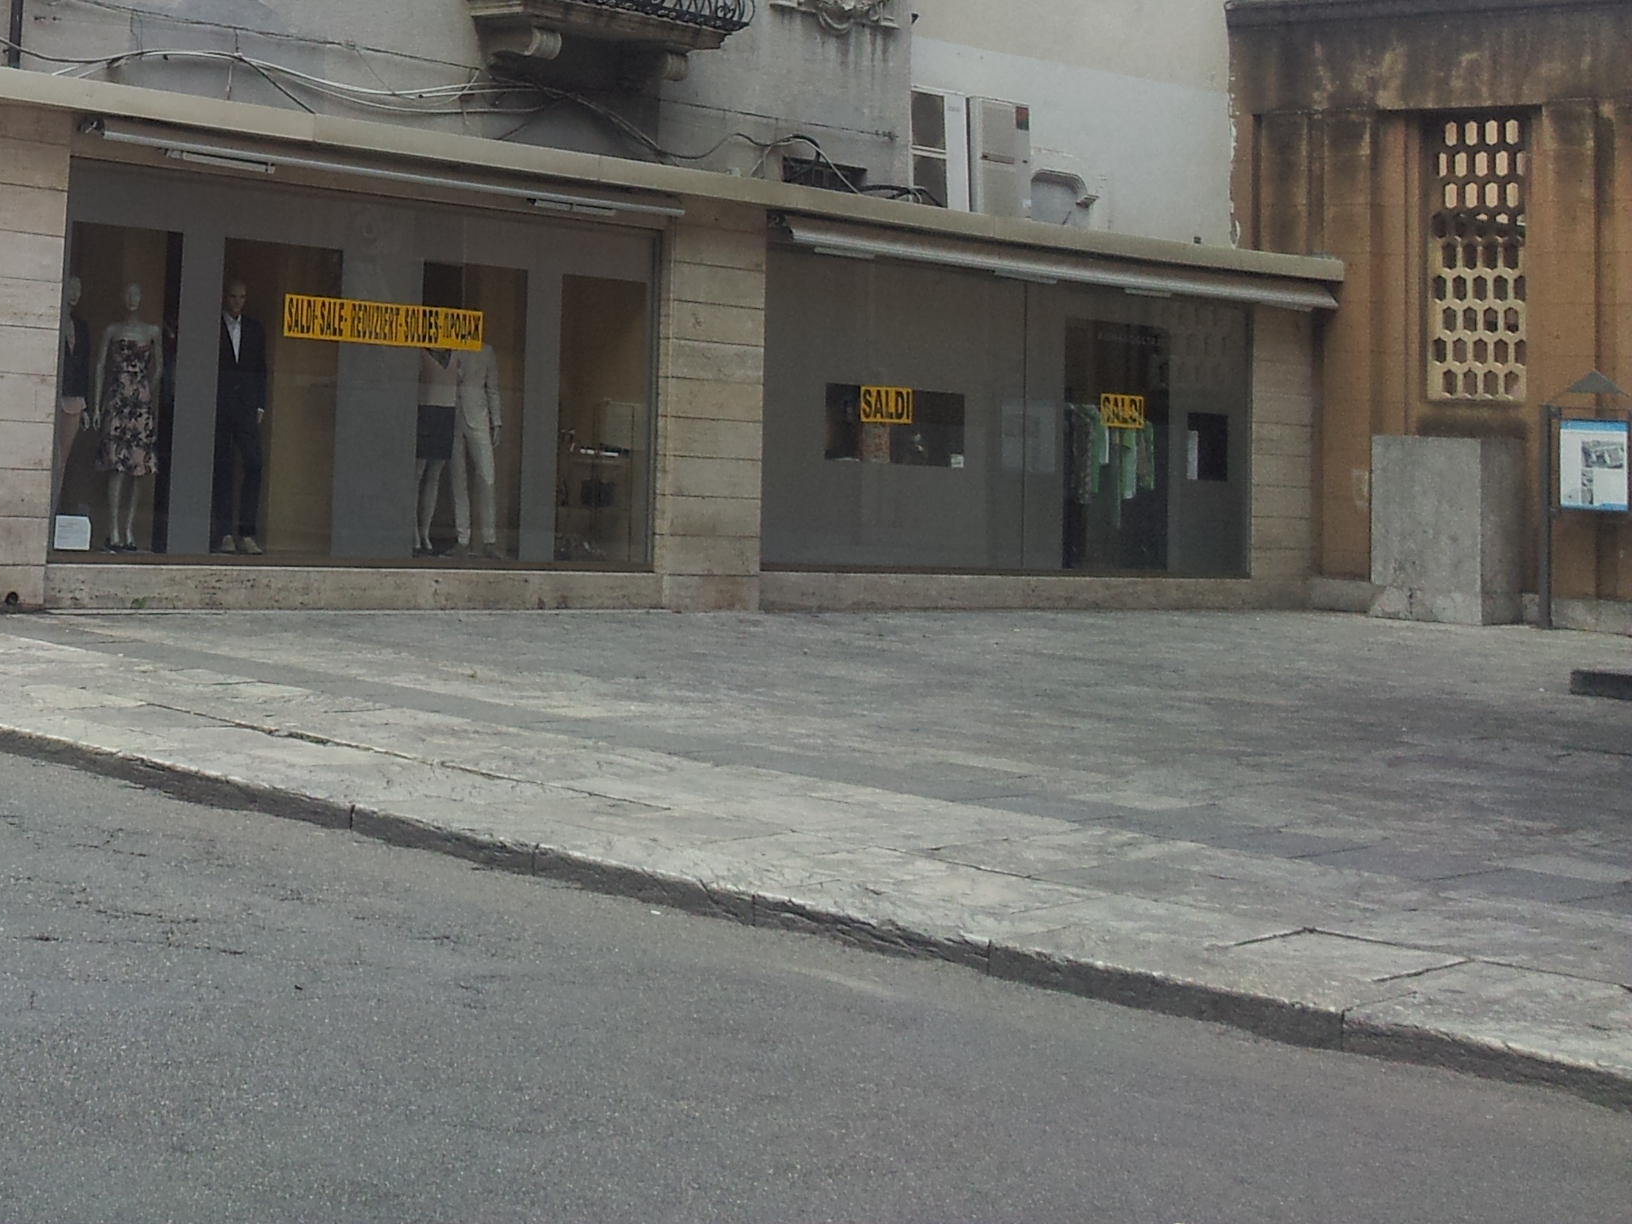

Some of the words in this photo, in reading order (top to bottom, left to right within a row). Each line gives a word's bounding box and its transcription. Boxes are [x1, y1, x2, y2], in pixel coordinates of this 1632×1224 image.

[287, 297, 317, 334] SALDI
[320, 300, 345, 336] SALE
[403, 308, 439, 344] SOLDES
[862, 388, 911, 420] SALDI
